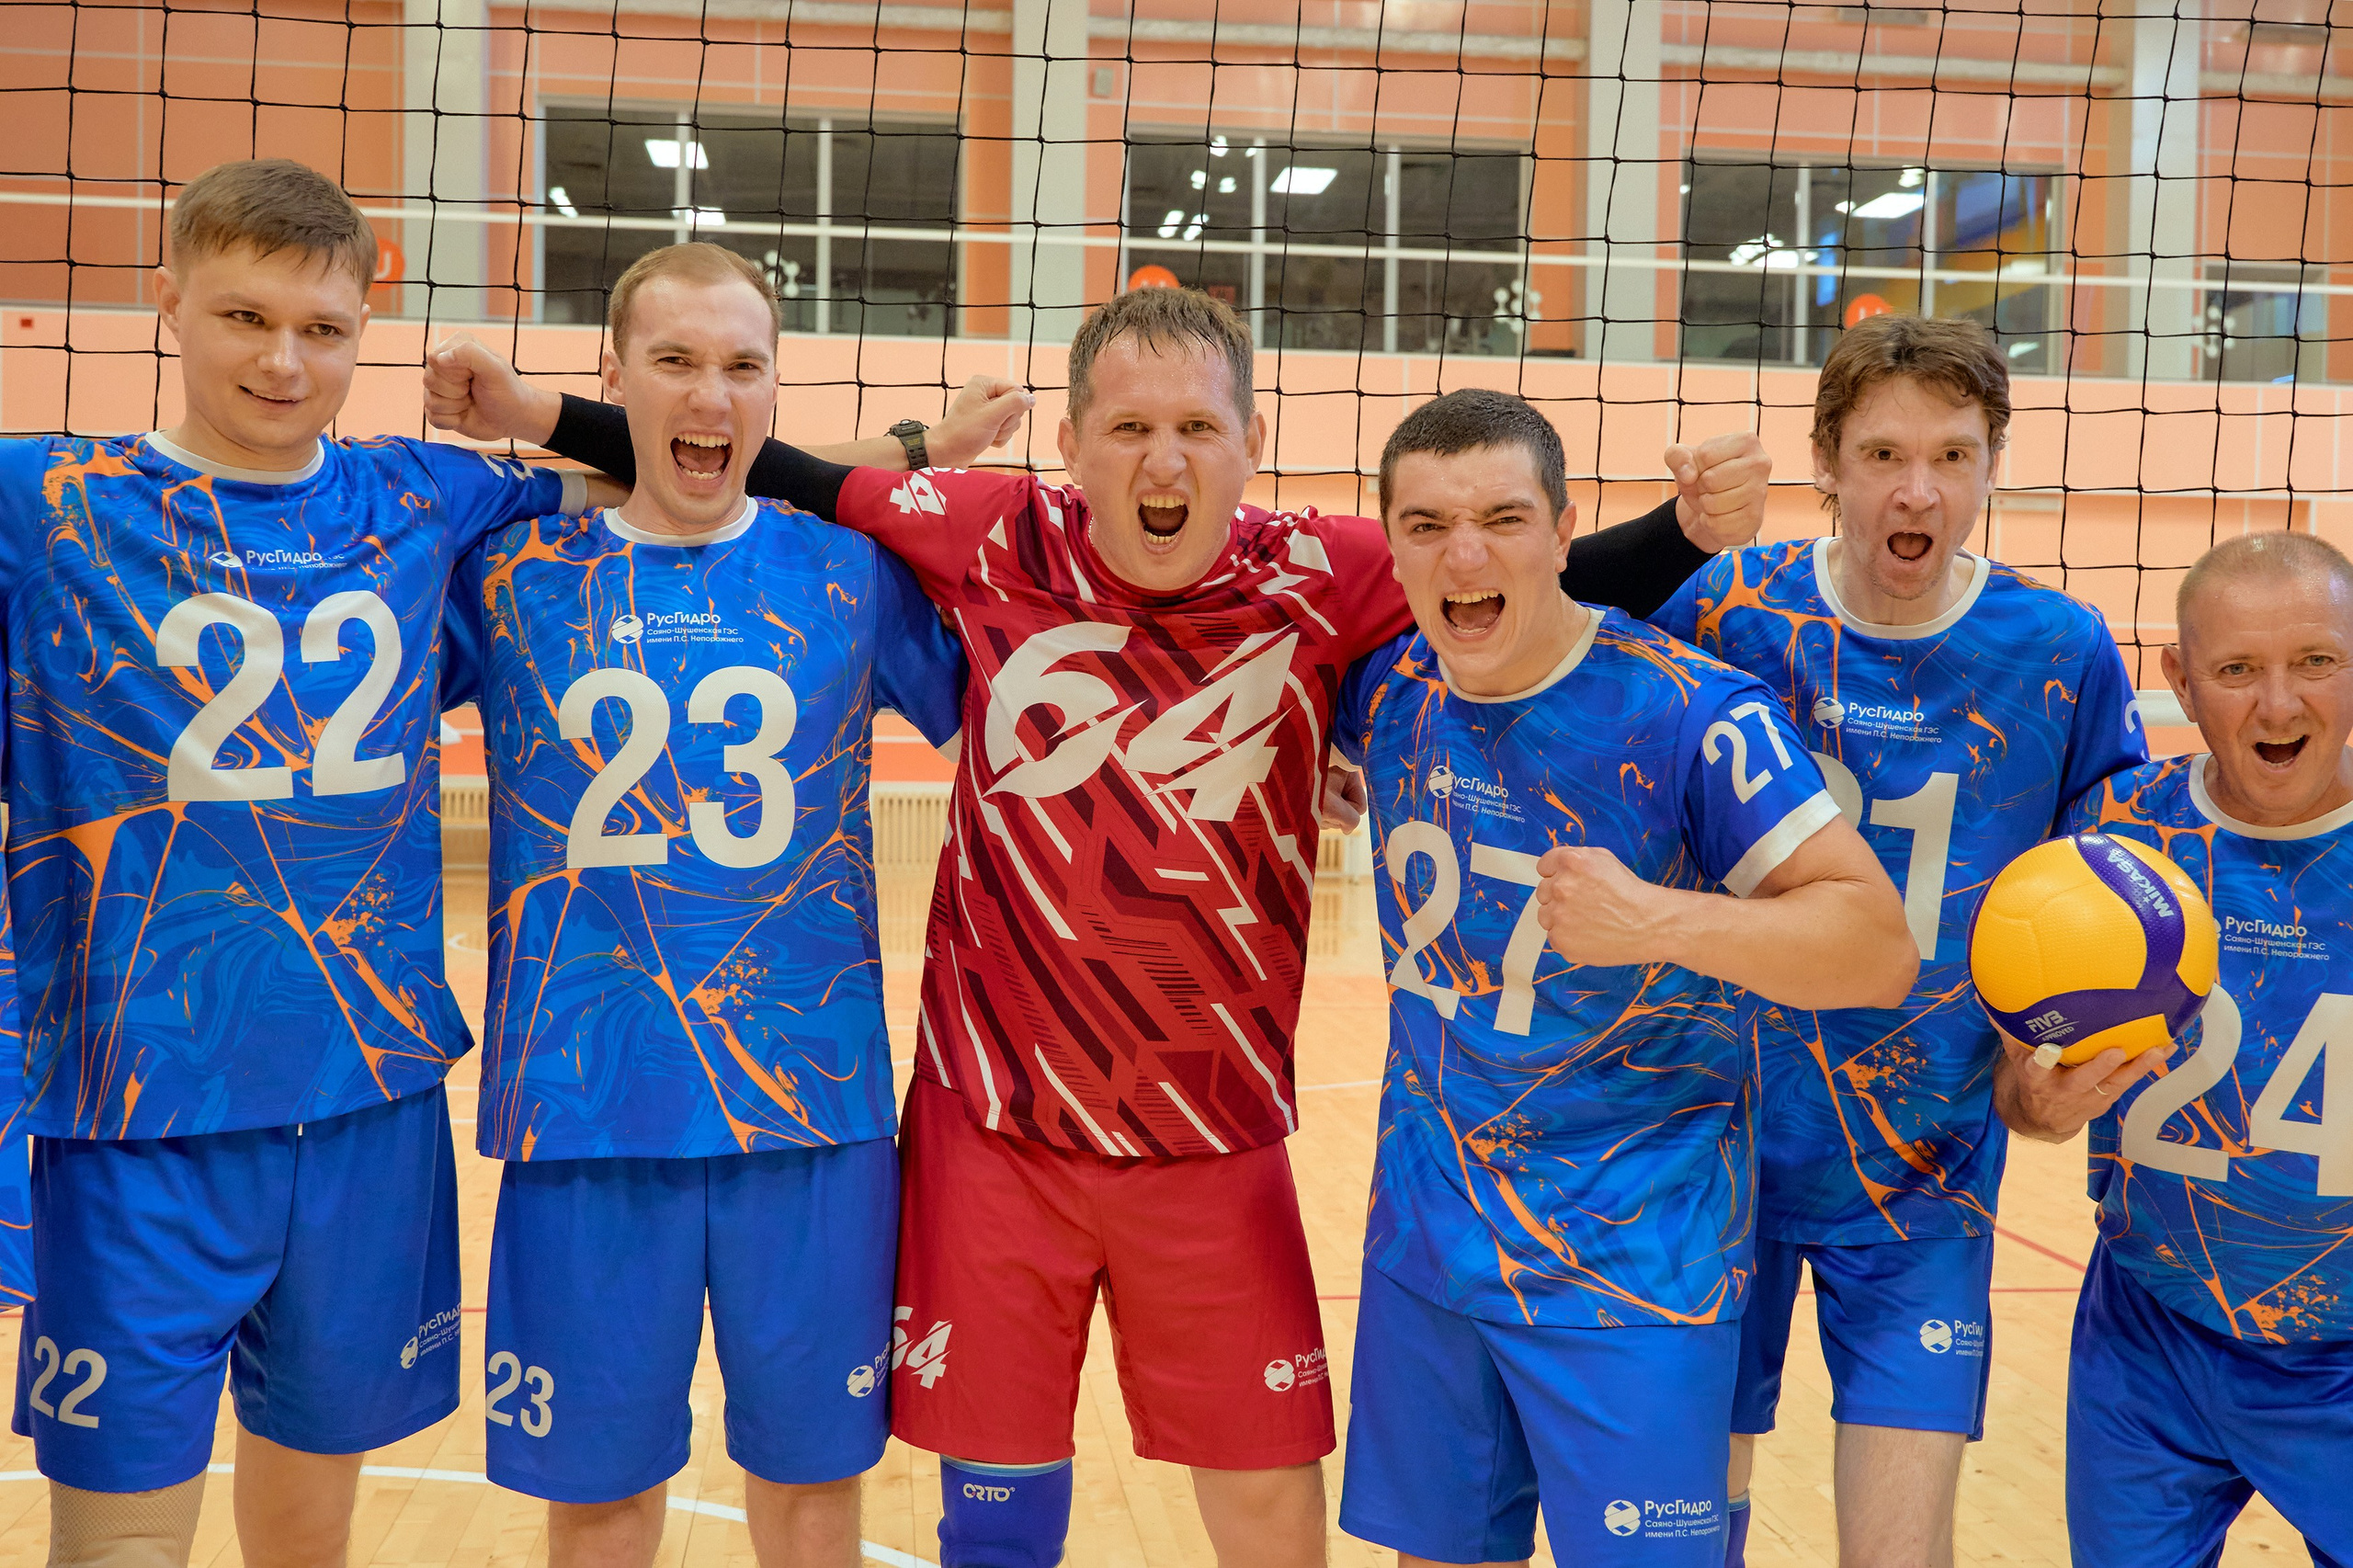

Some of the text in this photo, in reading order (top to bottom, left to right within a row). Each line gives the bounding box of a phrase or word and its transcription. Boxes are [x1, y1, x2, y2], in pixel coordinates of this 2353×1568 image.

[245, 550, 322, 566] РусГидро
[646, 612, 721, 627] РусГидро
[646, 627, 722, 636] Саяно-Шушенская
[155, 590, 406, 802] 22
[978, 621, 1306, 823] 64
[1848, 702, 1924, 723] РусГидро
[1846, 727, 1942, 744] имени П.С. Непорожнего
[1847, 718, 1939, 734] Саяно-Шушенская ГЭС
[1702, 701, 1793, 804] 27
[558, 665, 797, 869] 23
[1481, 807, 1526, 824] Непорожнего
[1509, 803, 1521, 813] ГЭС
[2107, 847, 2175, 918] MIKASA
[1386, 820, 1549, 1037] 27
[2225, 916, 2308, 938] РусГидро
[2224, 934, 2326, 950] Саяно-Шушенская ГЭС
[2223, 945, 2330, 960] имени П.С. Непорожнего
[2041, 1026, 2075, 1041] APPROVED
[2121, 982, 2353, 1197] 24
[29, 1335, 108, 1428] 22
[485, 1351, 554, 1437] 23
[1644, 1499, 1711, 1518] РусГидро
[1644, 1518, 1711, 1528] Саяно-Шушенская
